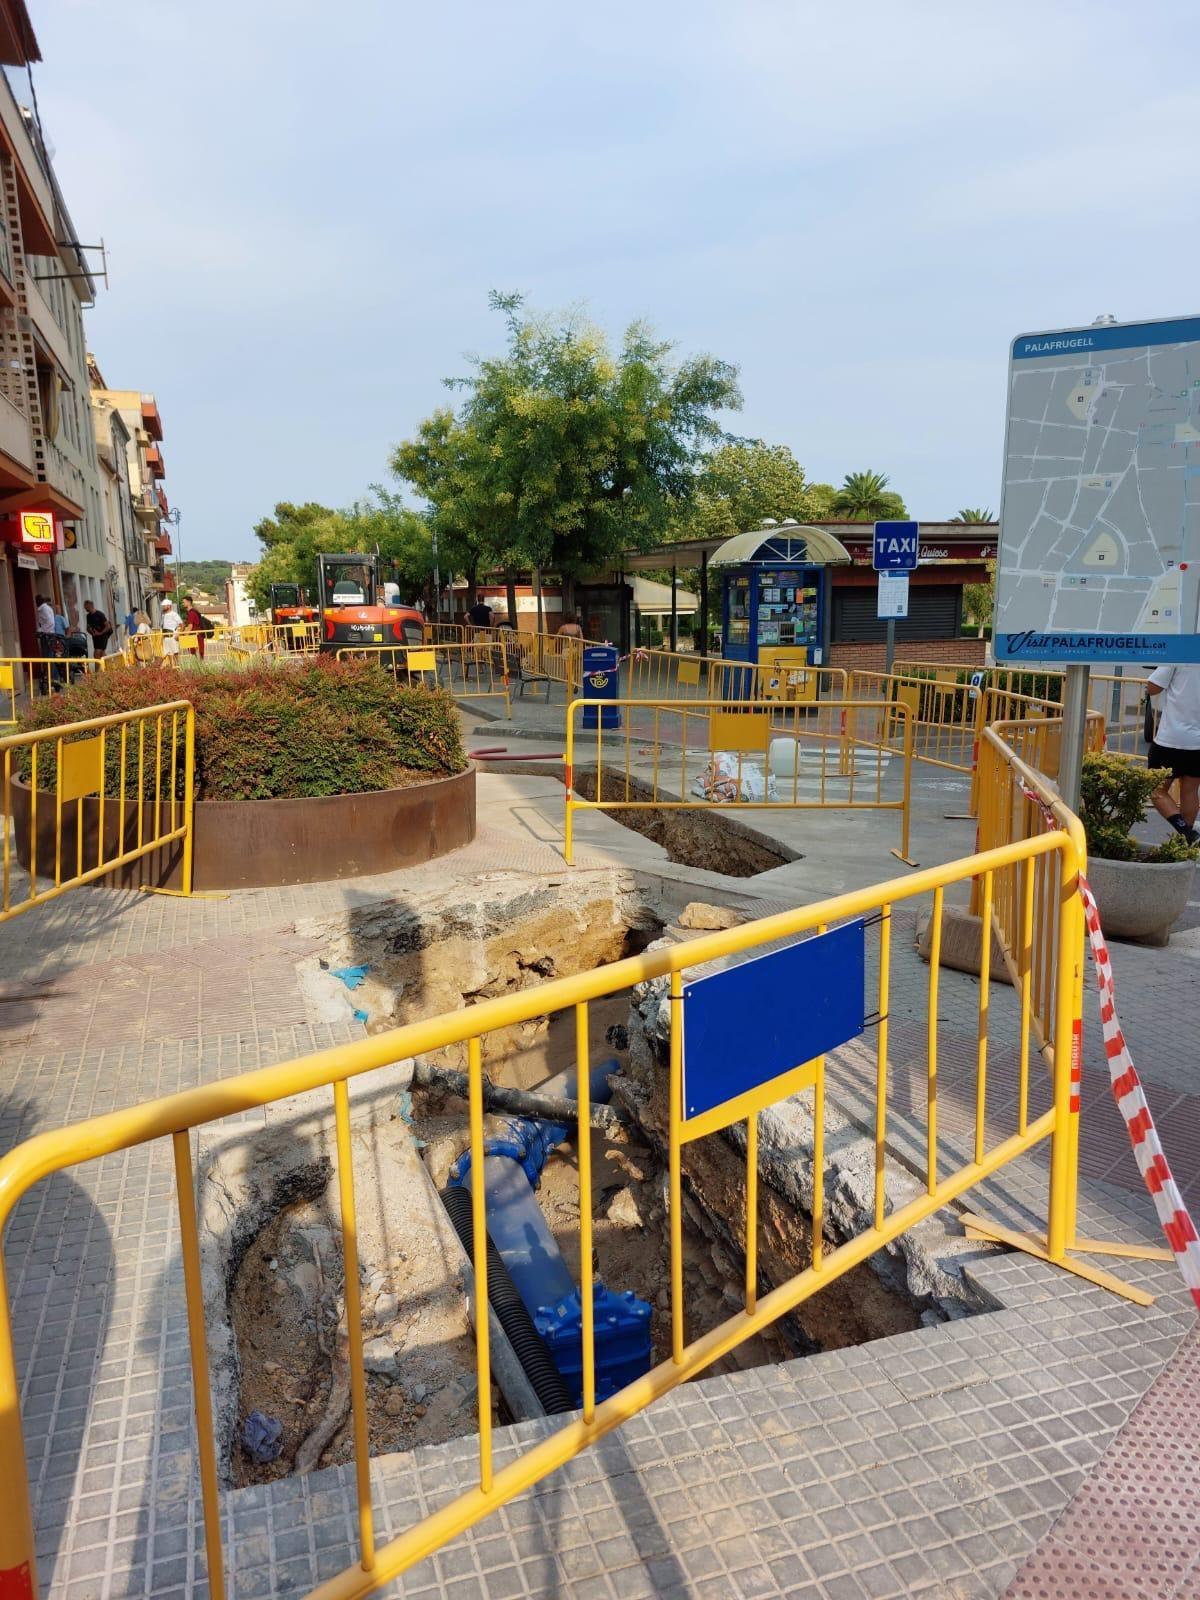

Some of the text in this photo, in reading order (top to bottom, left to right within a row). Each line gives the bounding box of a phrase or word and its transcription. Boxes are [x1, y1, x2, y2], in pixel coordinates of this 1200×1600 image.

[1024, 338, 1094, 352] PALAFRUGELL
[877, 538, 916, 553] TAXI
[1006, 630, 1051, 654] Visit
